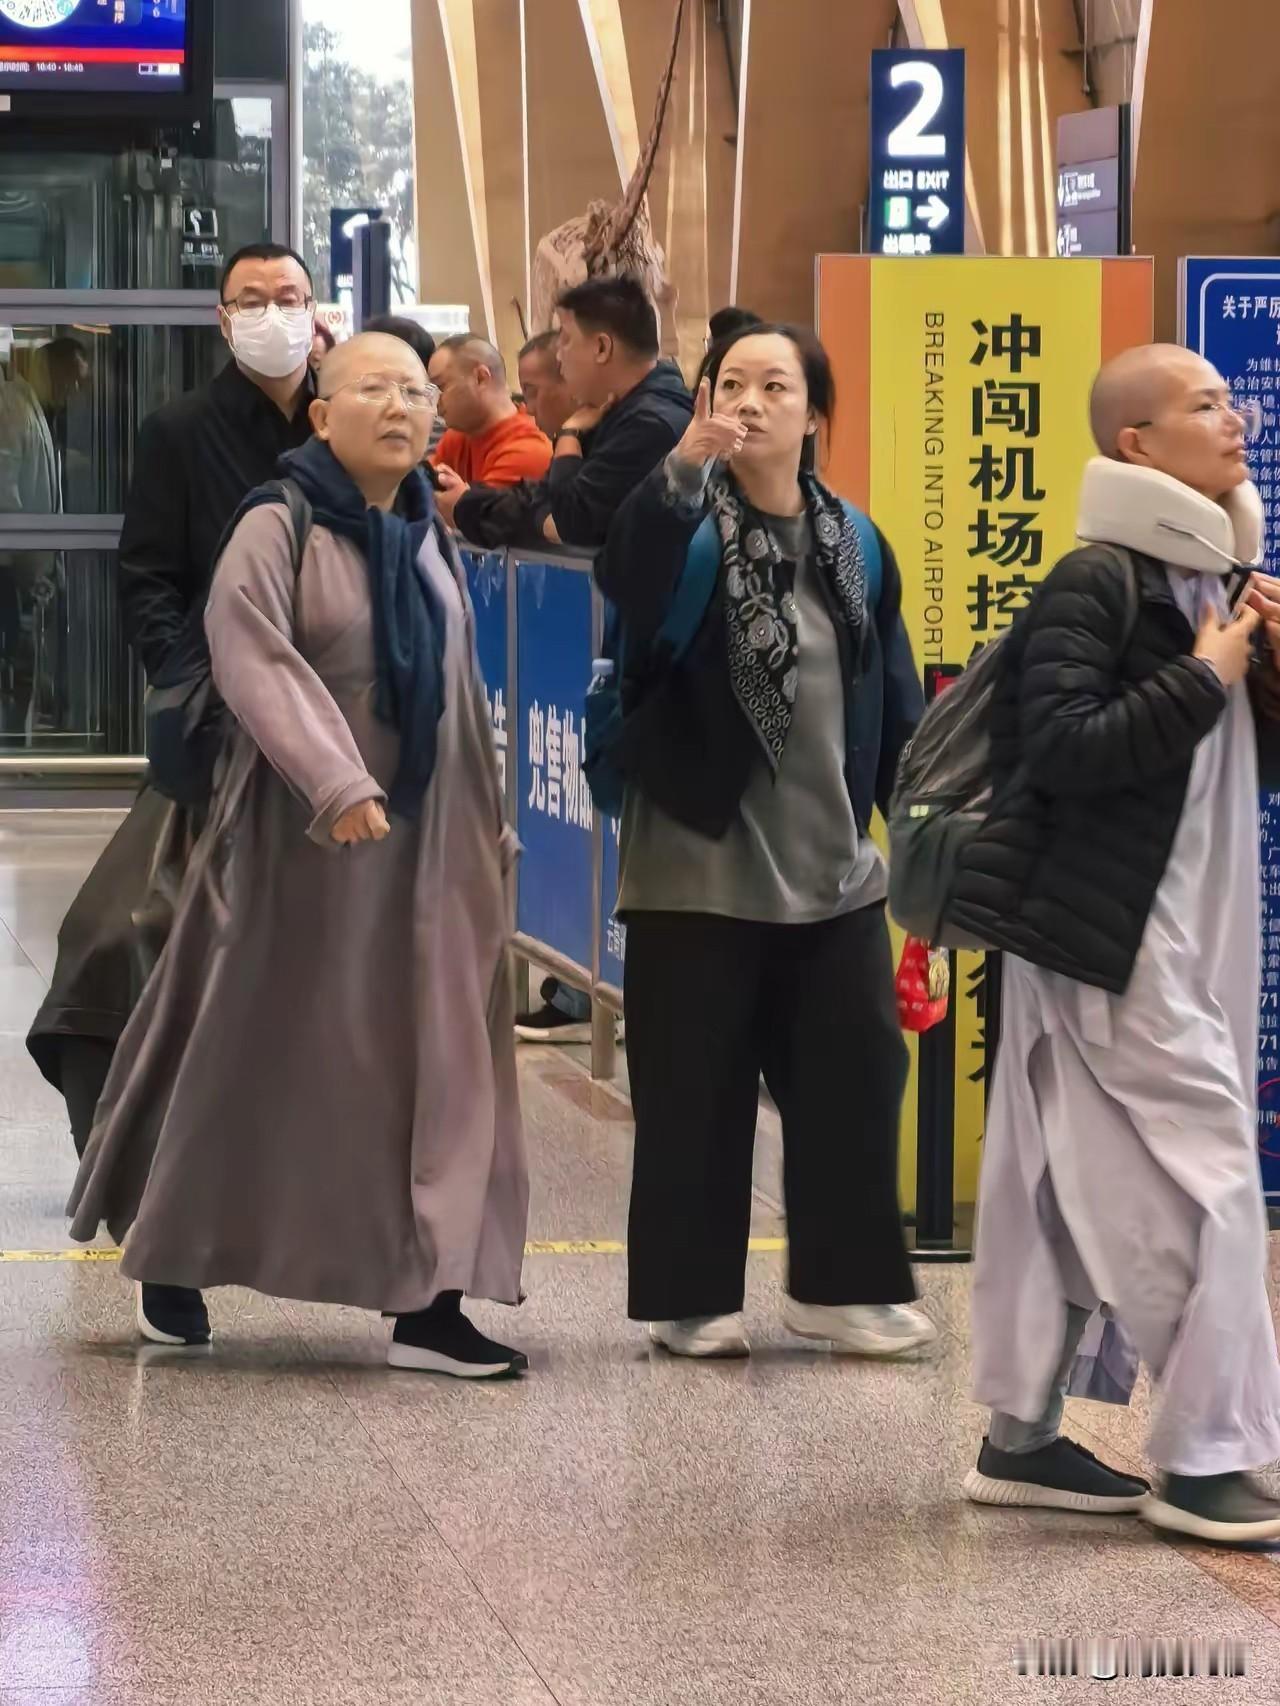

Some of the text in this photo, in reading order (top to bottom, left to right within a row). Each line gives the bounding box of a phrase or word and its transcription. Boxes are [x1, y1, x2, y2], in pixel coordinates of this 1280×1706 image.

[883, 170, 949, 190] 出口 EXIT
[887, 61, 946, 156] 2
[924, 312, 945, 664] BREAKING INTO AIRPORT
[966, 313, 1046, 668] 冲闯机场控
